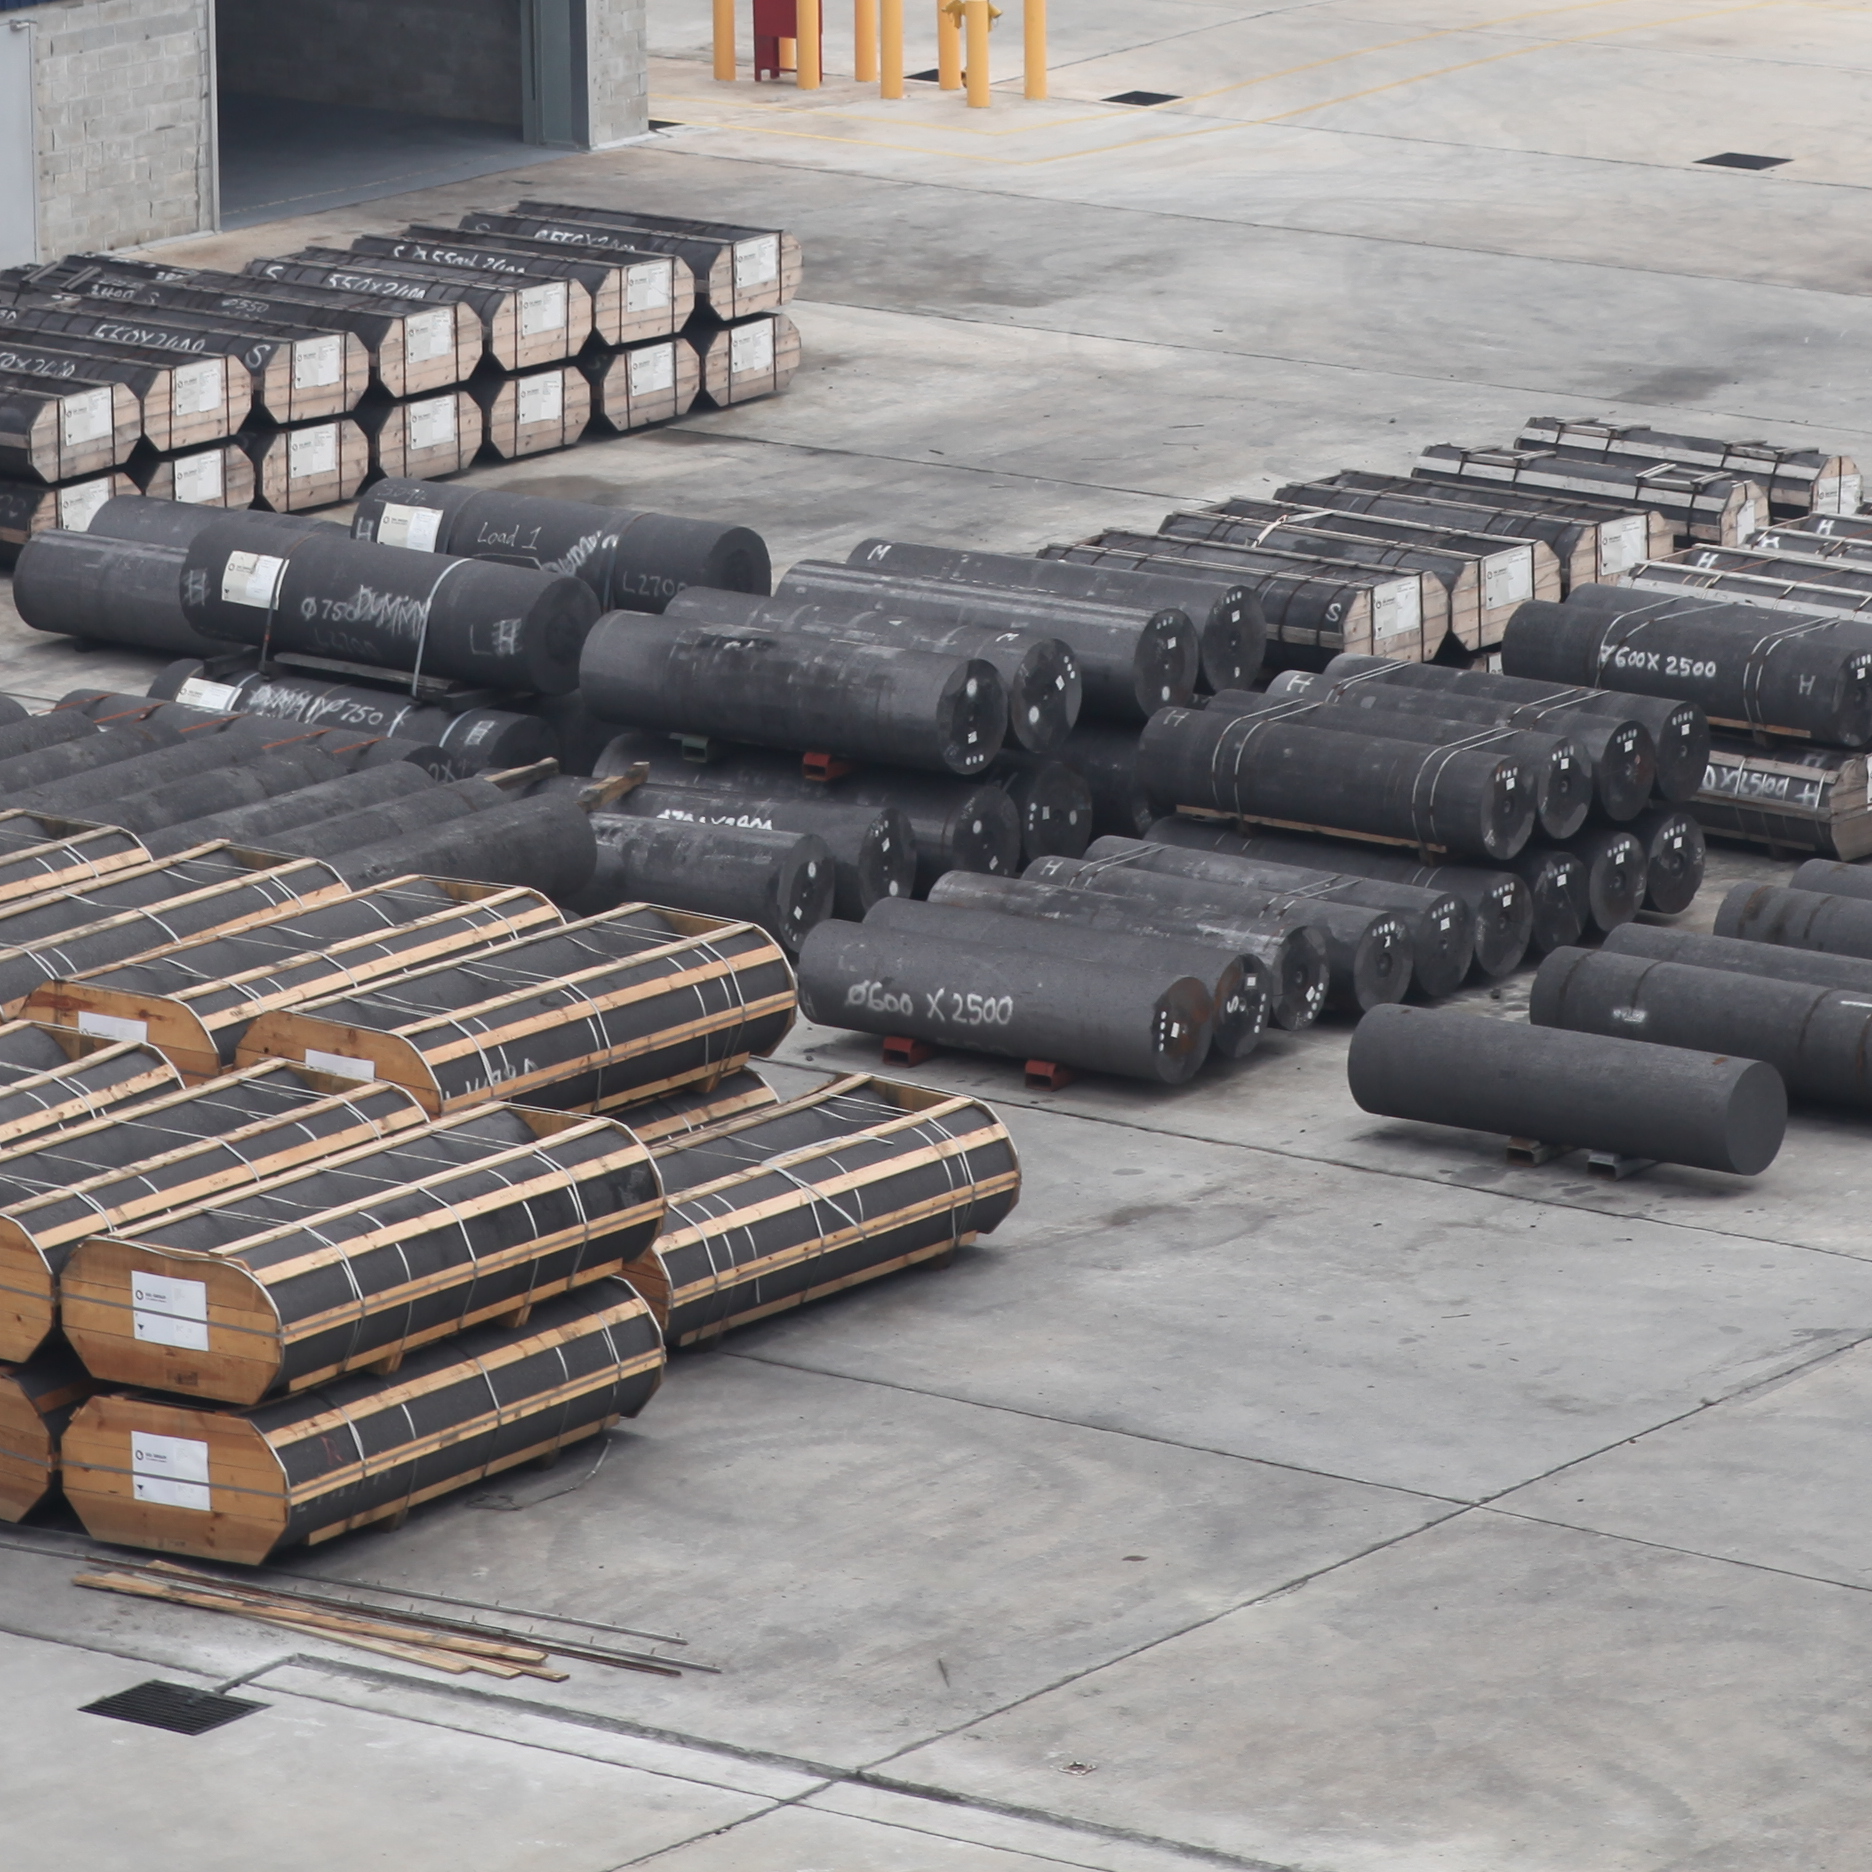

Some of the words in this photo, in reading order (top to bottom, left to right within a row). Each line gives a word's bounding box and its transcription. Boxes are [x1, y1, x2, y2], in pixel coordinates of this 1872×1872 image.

[477, 522, 519, 547] Load
[1665, 655, 1717, 678] 2500
[1286, 673, 1314, 693] H
[1798, 674, 1816, 696] H
[1039, 859, 1064, 876] H
[926, 986, 946, 1023] X
[950, 991, 1014, 1027] 2500
